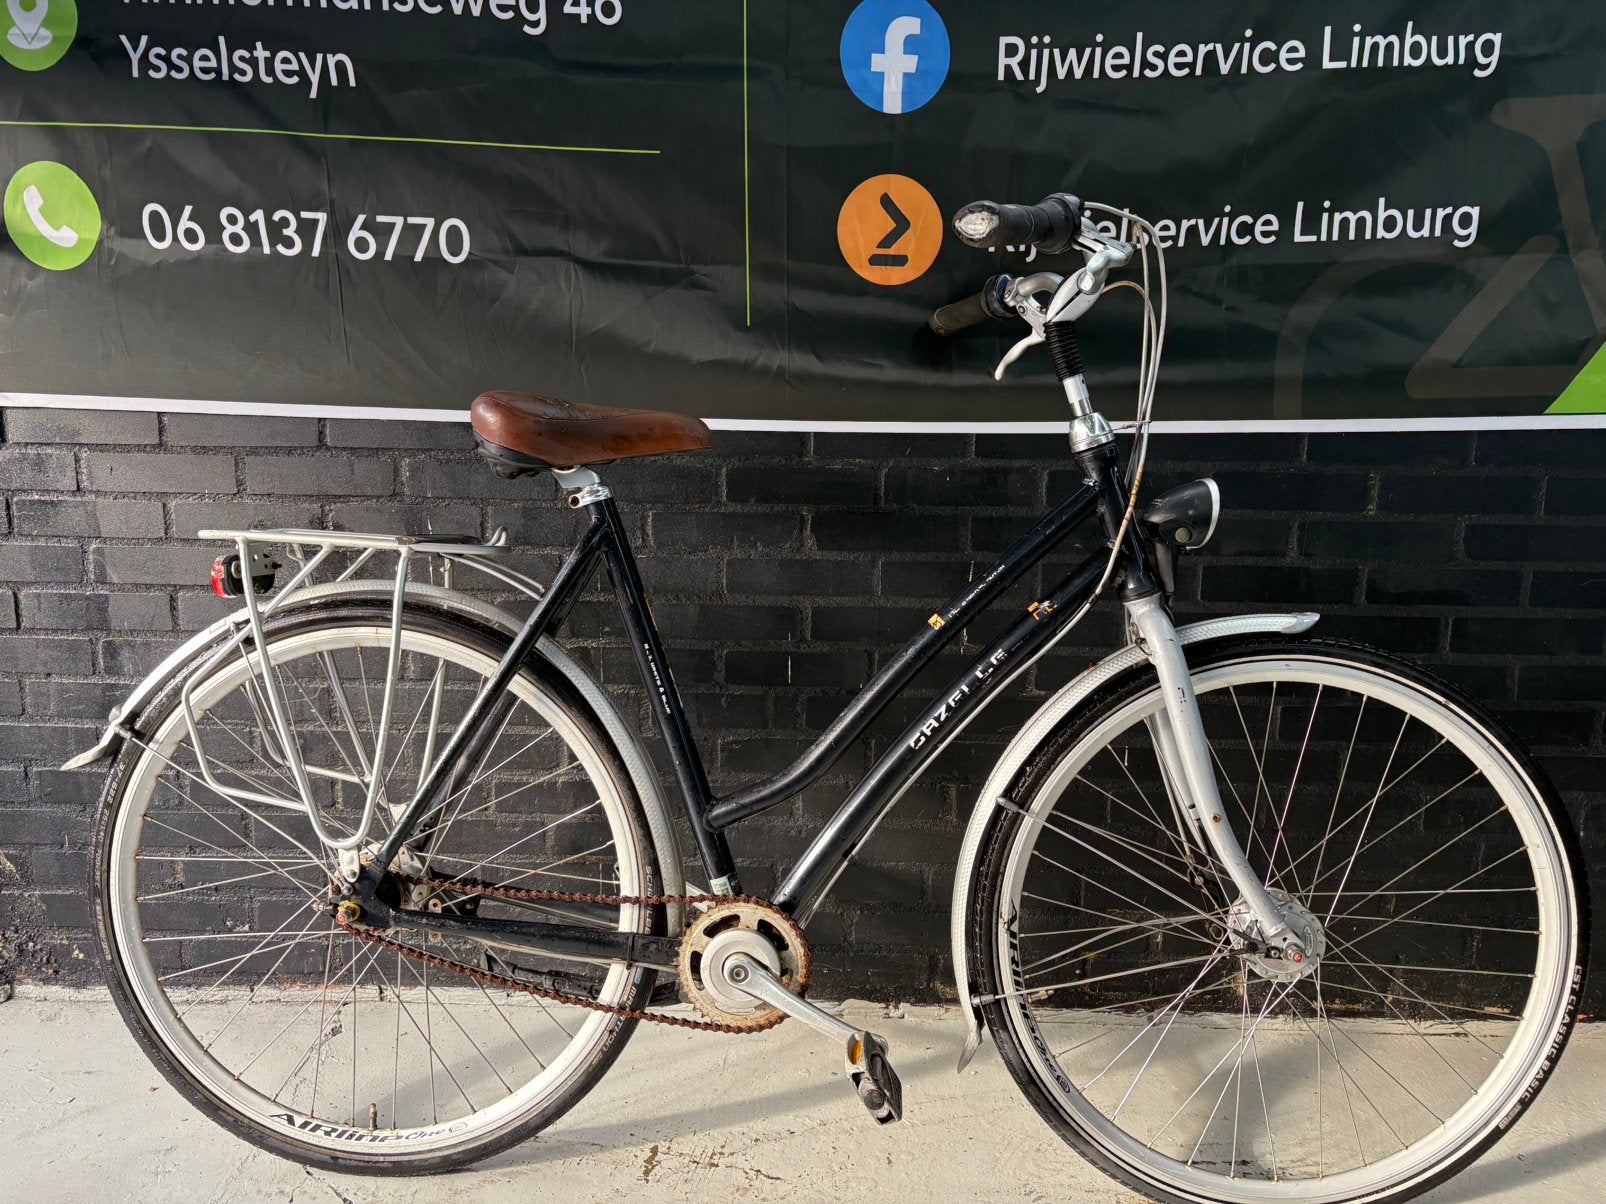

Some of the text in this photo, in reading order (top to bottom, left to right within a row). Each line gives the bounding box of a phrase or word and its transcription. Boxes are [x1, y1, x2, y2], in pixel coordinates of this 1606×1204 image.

[120, 35, 355, 98] Ysselsteyn
[998, 21, 1502, 93] Rijwielservice Limburg
[142, 203, 470, 263] 06 8137 6770
[988, 198, 1480, 262] elervice Limburg
[644, 865, 653, 935] SCHLBE
[1524, 965, 1582, 1102] CST CLASSIC BASIC
